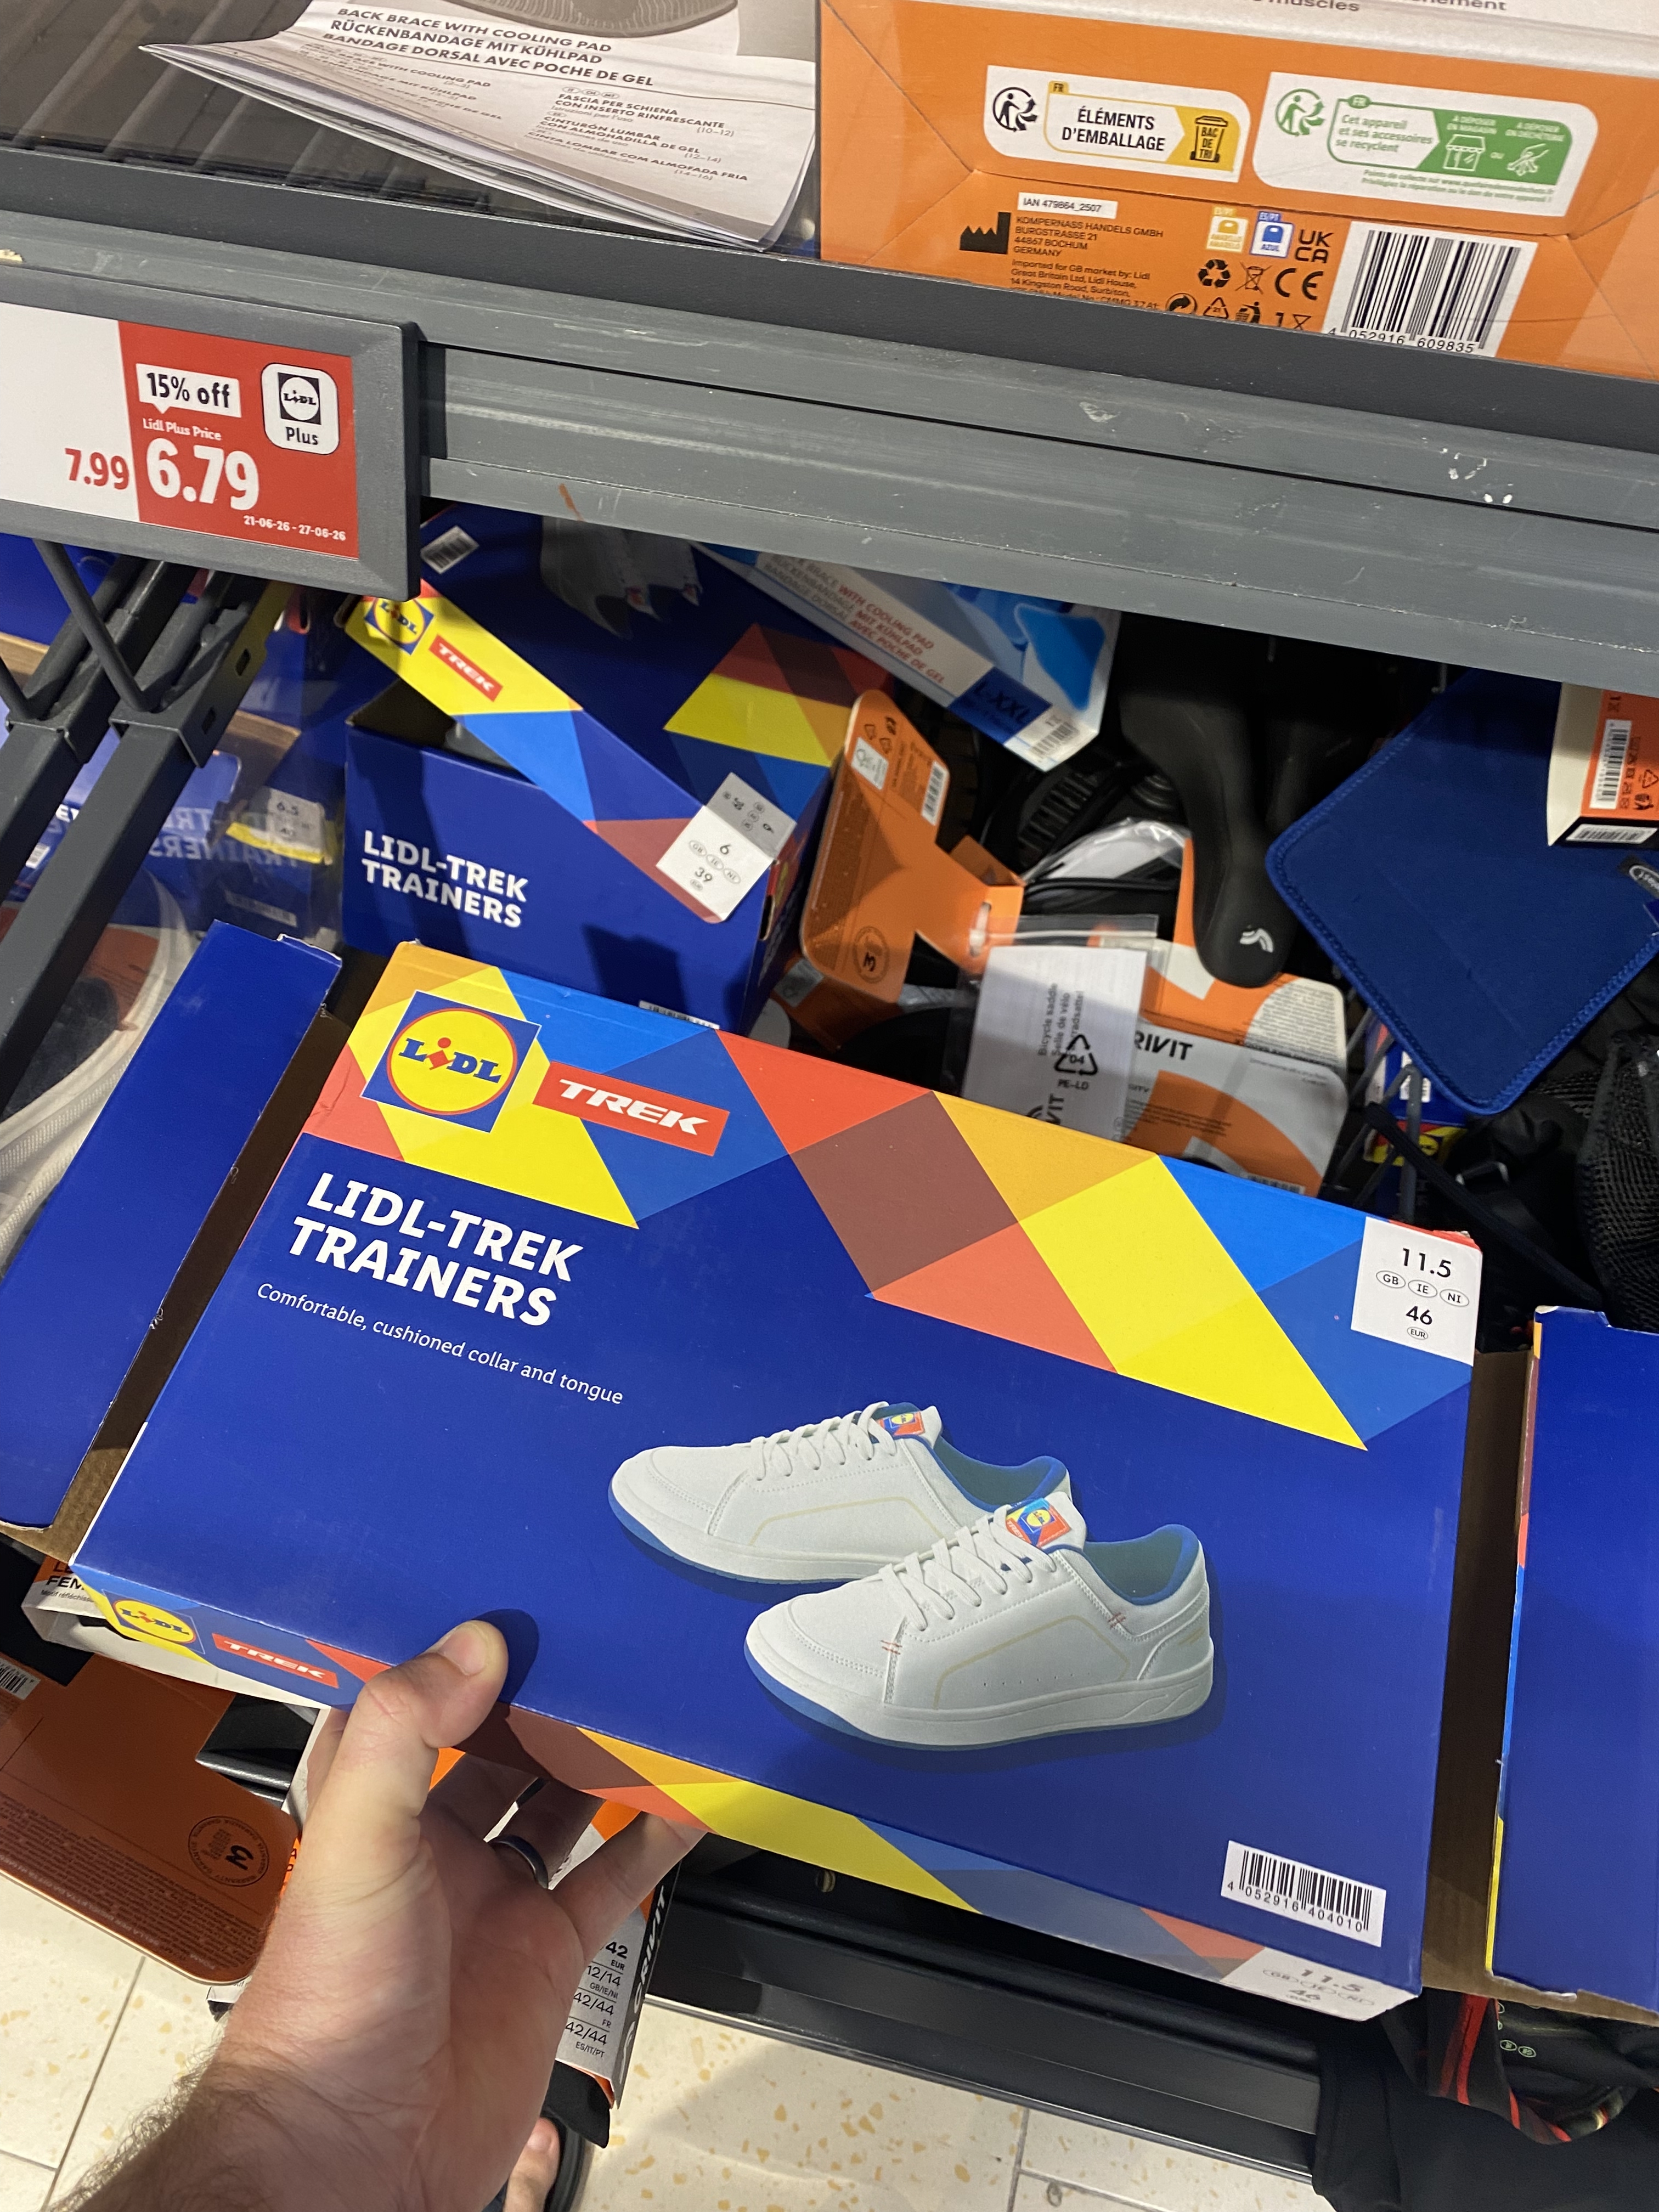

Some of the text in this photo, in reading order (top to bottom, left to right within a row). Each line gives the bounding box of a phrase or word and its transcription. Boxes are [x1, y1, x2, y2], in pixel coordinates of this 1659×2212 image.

[337, 8, 612, 52] BACK BRACE WITH COOLING PAD
[330, 20, 602, 64] RÜCKENBANDAGE MIT KÜHLPAD
[322, 33, 409, 52] BANDAGE
[411, 46, 481, 63] DORSAL
[484, 56, 531, 69] AVEC
[533, 61, 592, 77] POCHE
[597, 70, 619, 81] DE
[622, 74, 654, 86] GEL
[410, 69, 465, 82] COOLING
[555, 100, 725, 128] CON INSERTO RINFRESCANTE
[558, 94, 599, 104] FASCIA
[625, 103, 678, 115] SCHIENA
[544, 116, 661, 141] CINTURÓN LUMBAR
[1077, 106, 1154, 131] ÉLÉMENTS
[1342, 115, 1408, 129] Cet appareil
[569, 127, 657, 147] ALMOHADILLA
[1350, 141, 1399, 153] recyclent
[1372, 132, 1433, 144] accessoires
[528, 132, 748, 181] CINTA LOMBAR COM ALMOFADA FRIA
[1023, 198, 1040, 207] IAN
[1015, 226, 1098, 241] BURGSTRASSE 21
[1085, 222, 1132, 234] HANDELS
[1133, 227, 1164, 238] GMBH
[1298, 229, 1334, 247] UK
[1013, 246, 1062, 257] GERMANY
[1044, 239, 1087, 250] BOCHUM
[1295, 247, 1329, 263] CA
[1011, 268, 1037, 277] Great
[1038, 270, 1069, 280] Britain
[1084, 267, 1117, 276] market
[1022, 279, 1062, 291] Kingston
[1417, 337, 1475, 353] 609835
[146, 372, 230, 408] 15% off
[143, 417, 222, 441] Lidl Plus Price
[285, 426, 318, 445] Plus
[65, 448, 129, 489] 7.99
[146, 437, 259, 511] 6.79
[244, 516, 345, 540] 21-06-26 27-06-26
[837, 584, 935, 651] WITH COOLING PAD
[854, 609, 924, 657] MIT KÜHLPAD
[848, 618, 946, 685] AVEC POCHE DE GEL
[438, 644, 494, 691] TREK
[720, 844, 731, 855] 6
[364, 831, 528, 902] LIDL-TREK
[695, 867, 712, 882] 39
[361, 859, 522, 928] TRAINERS
[1038, 983, 1058, 1056] Bicycle saddle
[1056, 1015, 1066, 1029] de
[1051, 1031, 1064, 1056] Selle
[1135, 1031, 1192, 1060] RIVIT
[1070, 1054, 1085, 1064] 04
[558, 1078, 709, 1136] TREK
[307, 1172, 584, 1282] LIDL-TREK
[289, 1217, 558, 1326] TRAINERS
[1402, 1248, 1452, 1278] 11.5
[1383, 1274, 1460, 1303] GB IE NI
[1406, 1306, 1432, 1325] 46
[257, 1282, 624, 1404] Comfortable, cushioned collar and tongue
[1410, 1329, 1426, 1339] EUR
[224, 1641, 324, 1679] TREK
[225, 1845, 254, 1871] 3
[1227, 1882, 1363, 1933] 4 052916 404010
[588, 1965, 620, 1987] 12/14
[611, 1960, 624, 1971] EUR
[590, 1983, 618, 1999] GB/IE/NI
[1301, 1970, 1363, 1992] 11.5
[574, 1992, 614, 2016] 42/44
[1290, 1990, 1321, 2000] 46
[565, 2022, 607, 2045] 42/44
[602, 2019, 611, 2028] FR
[575, 2041, 605, 2057] ES/IT/PT
